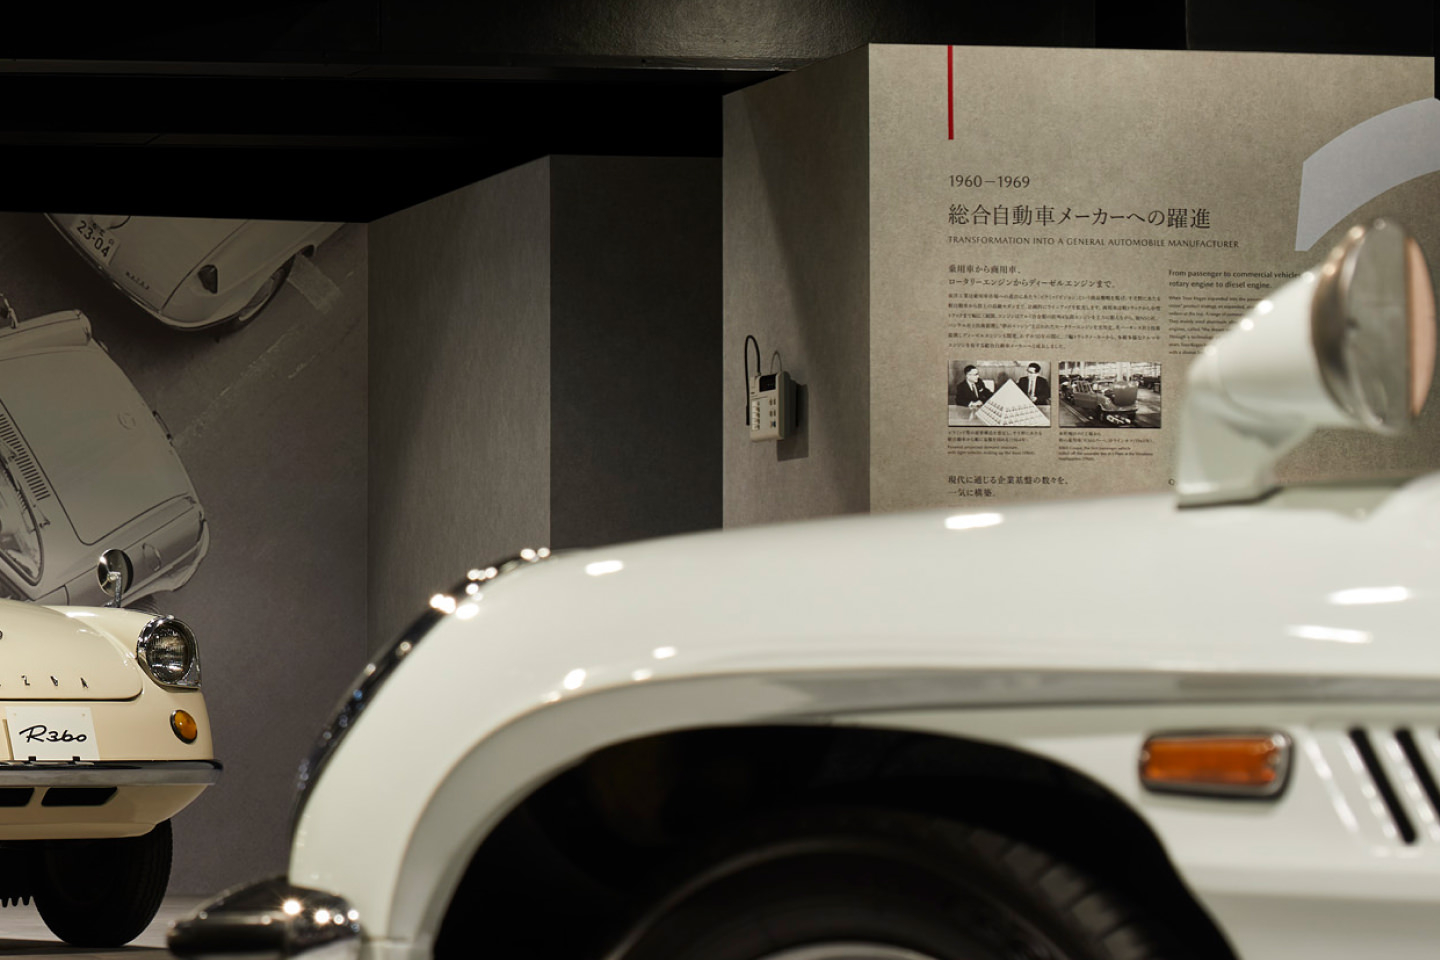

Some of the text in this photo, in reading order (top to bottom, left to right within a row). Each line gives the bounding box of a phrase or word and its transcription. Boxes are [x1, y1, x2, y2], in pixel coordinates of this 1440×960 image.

[948, 203, 1212, 230] 総合自動車メーカーへの躍進
[948, 235, 1241, 249] TRANSFORMATION INTO A GENERAL AUTOMOBILE MANUFACTURER
[1168, 269, 1187, 277] From
[1187, 270, 1223, 281] passenger
[1223, 270, 1232, 278] to
[1232, 271, 1273, 279] commercial
[1168, 279, 1190, 289] rotary
[1190, 280, 1215, 290] engine
[1215, 280, 1224, 288] to
[1224, 280, 1246, 289] diesel
[18, 723, 88, 744] R360
